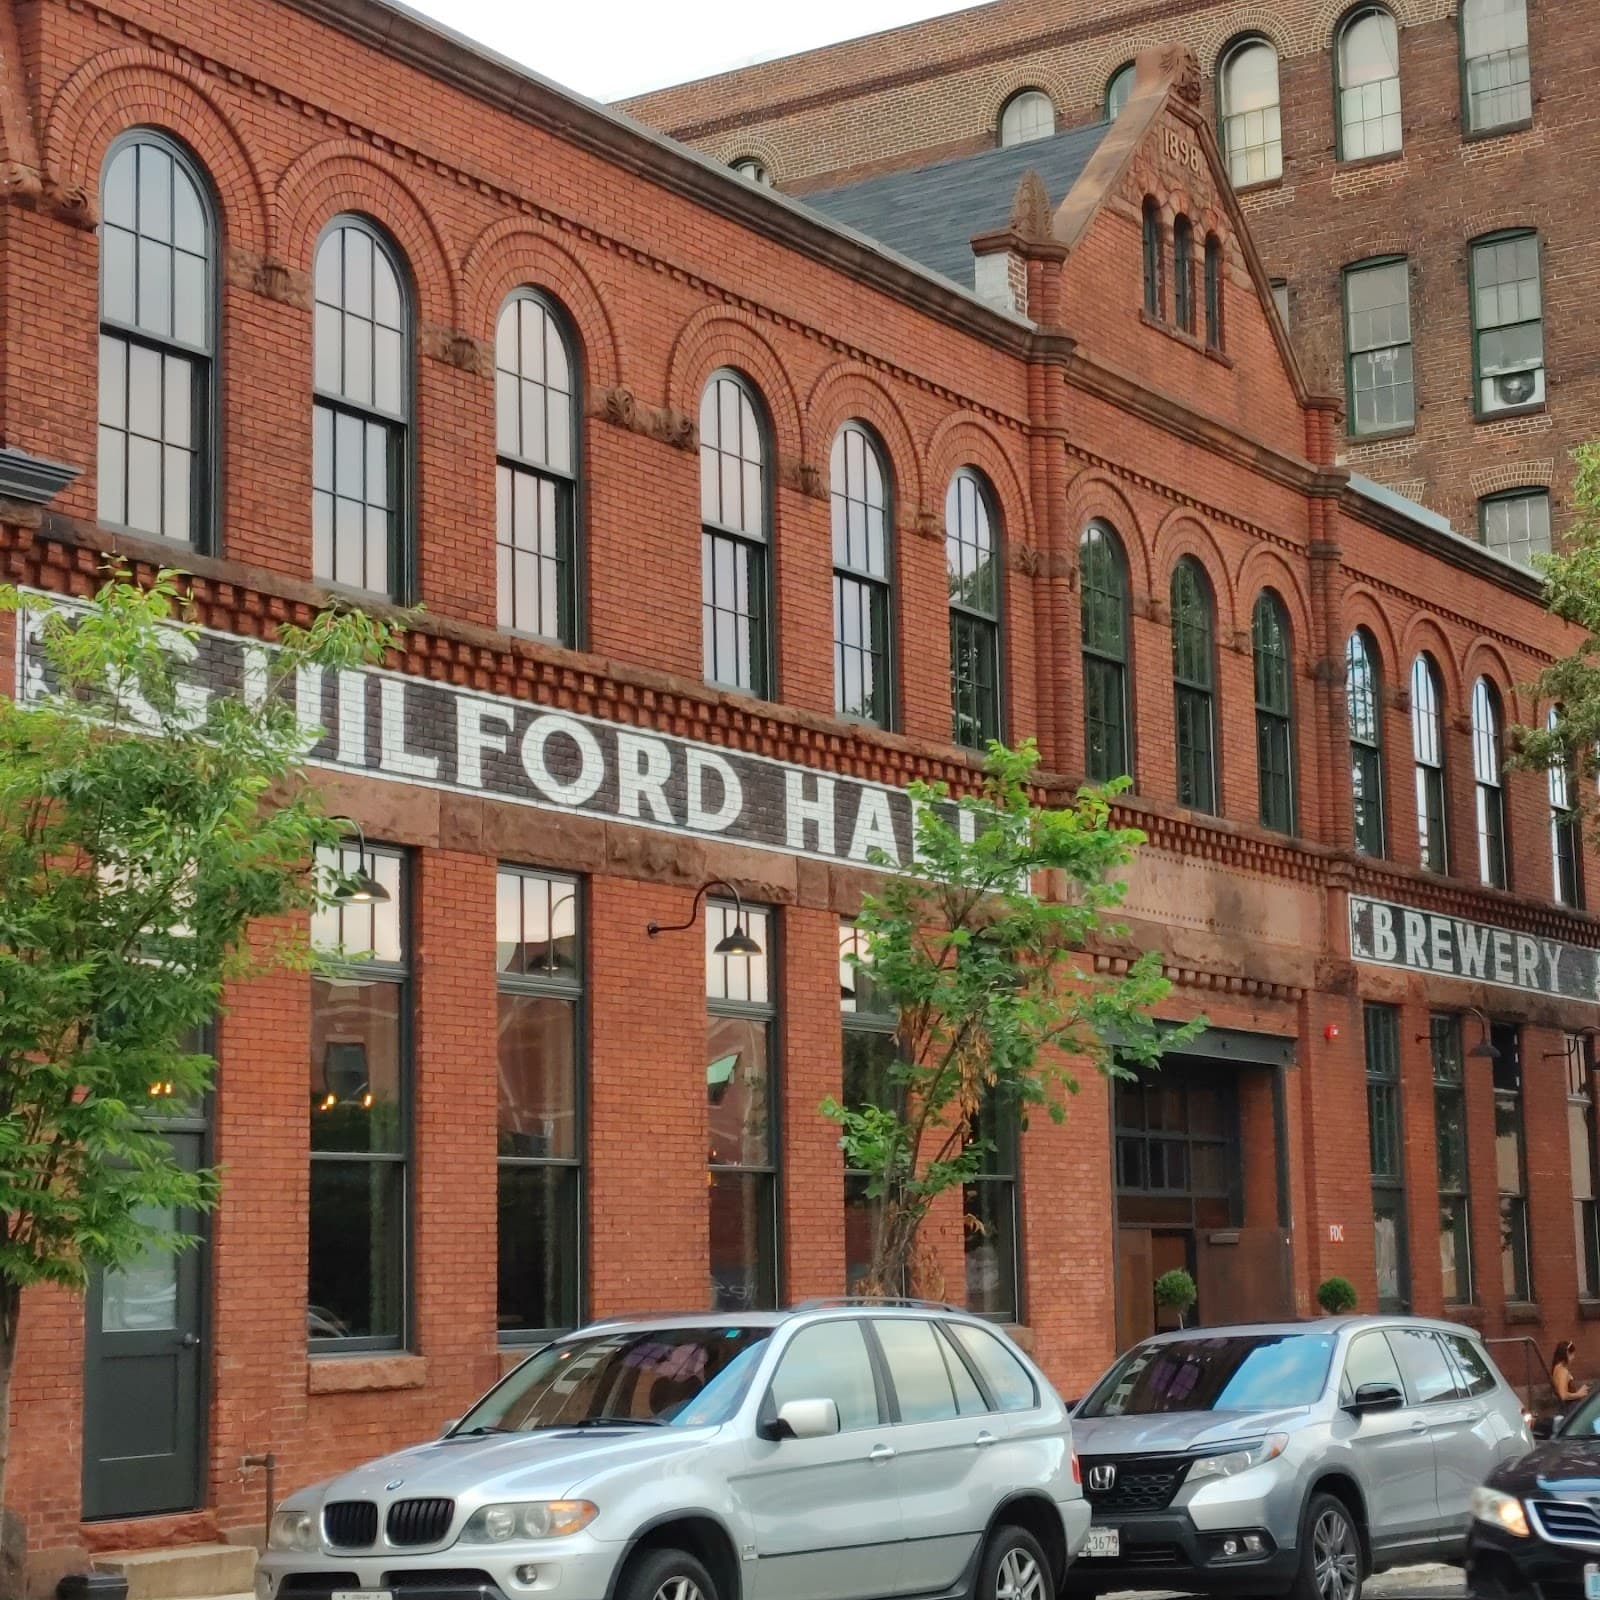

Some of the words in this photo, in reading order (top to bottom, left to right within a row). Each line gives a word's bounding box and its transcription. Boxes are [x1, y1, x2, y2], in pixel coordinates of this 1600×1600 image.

[1164, 127, 1199, 172] 1898
[1373, 905, 1562, 992] BREWERY
[1329, 1224, 1344, 1242] FDC
